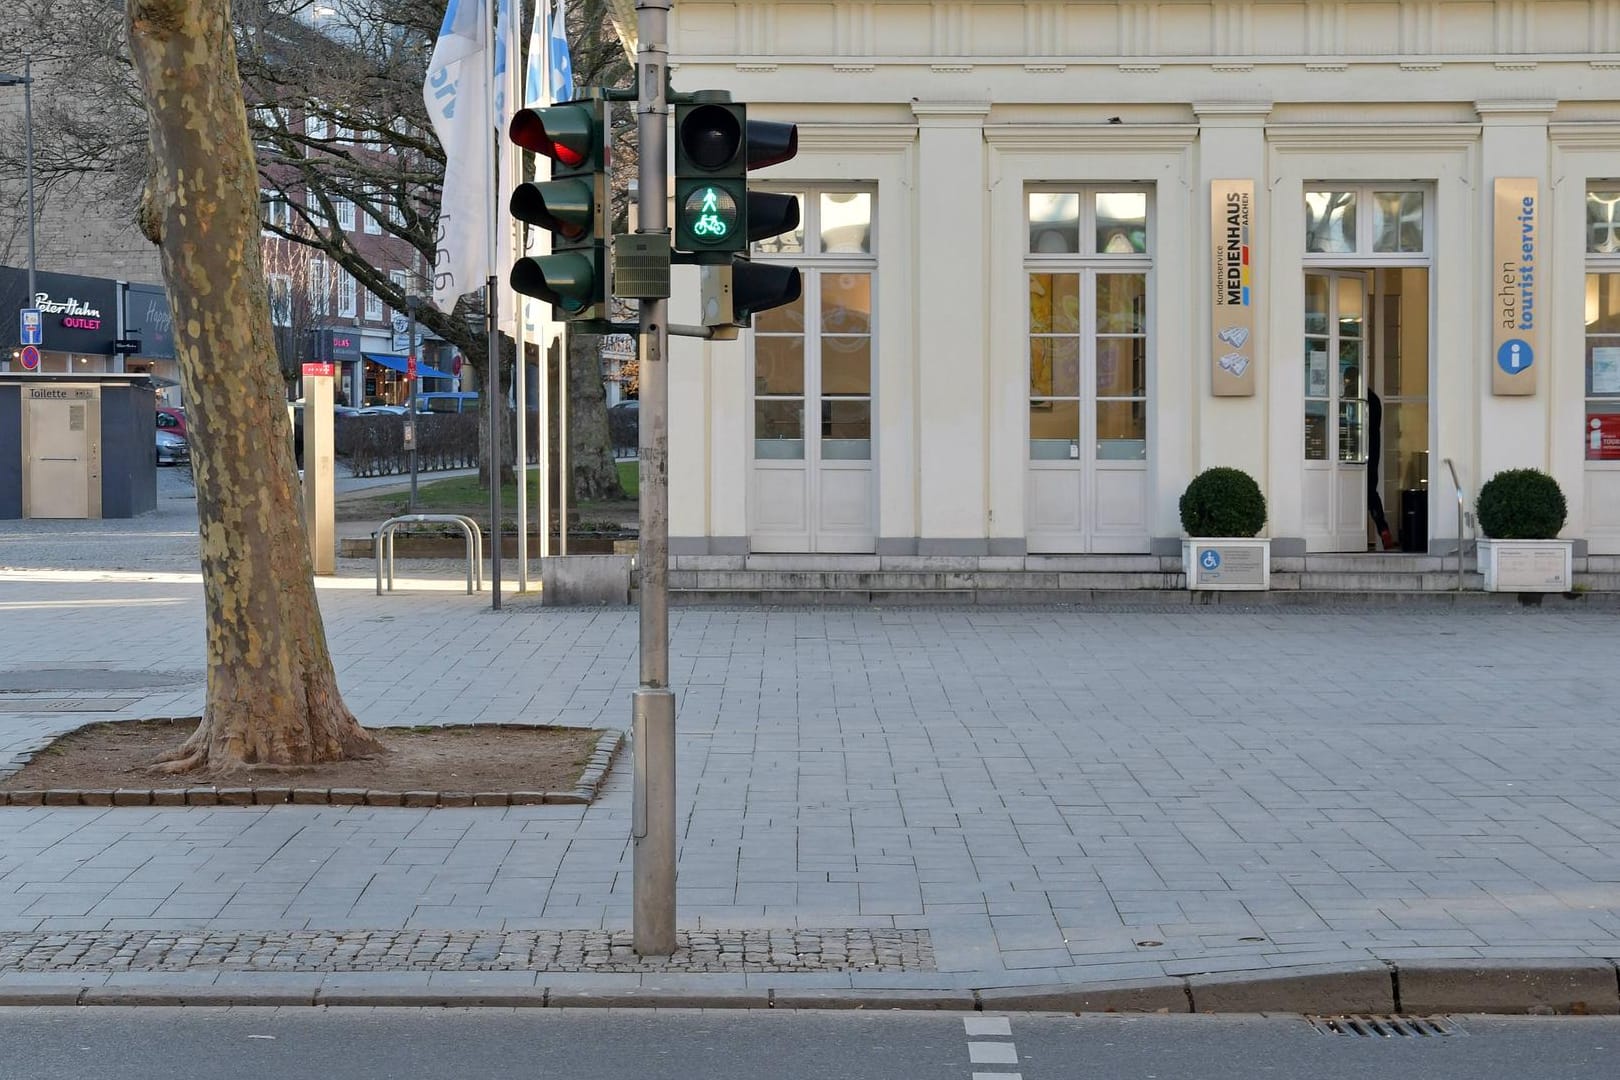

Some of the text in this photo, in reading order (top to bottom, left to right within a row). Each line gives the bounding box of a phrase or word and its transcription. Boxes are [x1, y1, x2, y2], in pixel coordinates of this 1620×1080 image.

[1216, 245, 1224, 305] Kundenservice
[1227, 192, 1241, 305] MEDIENHAUS
[1518, 196, 1534, 331] tourist service
[64, 317, 101, 330] OUTLET
[1499, 261, 1516, 329] aachen
[29, 388, 67, 399] Toilette
